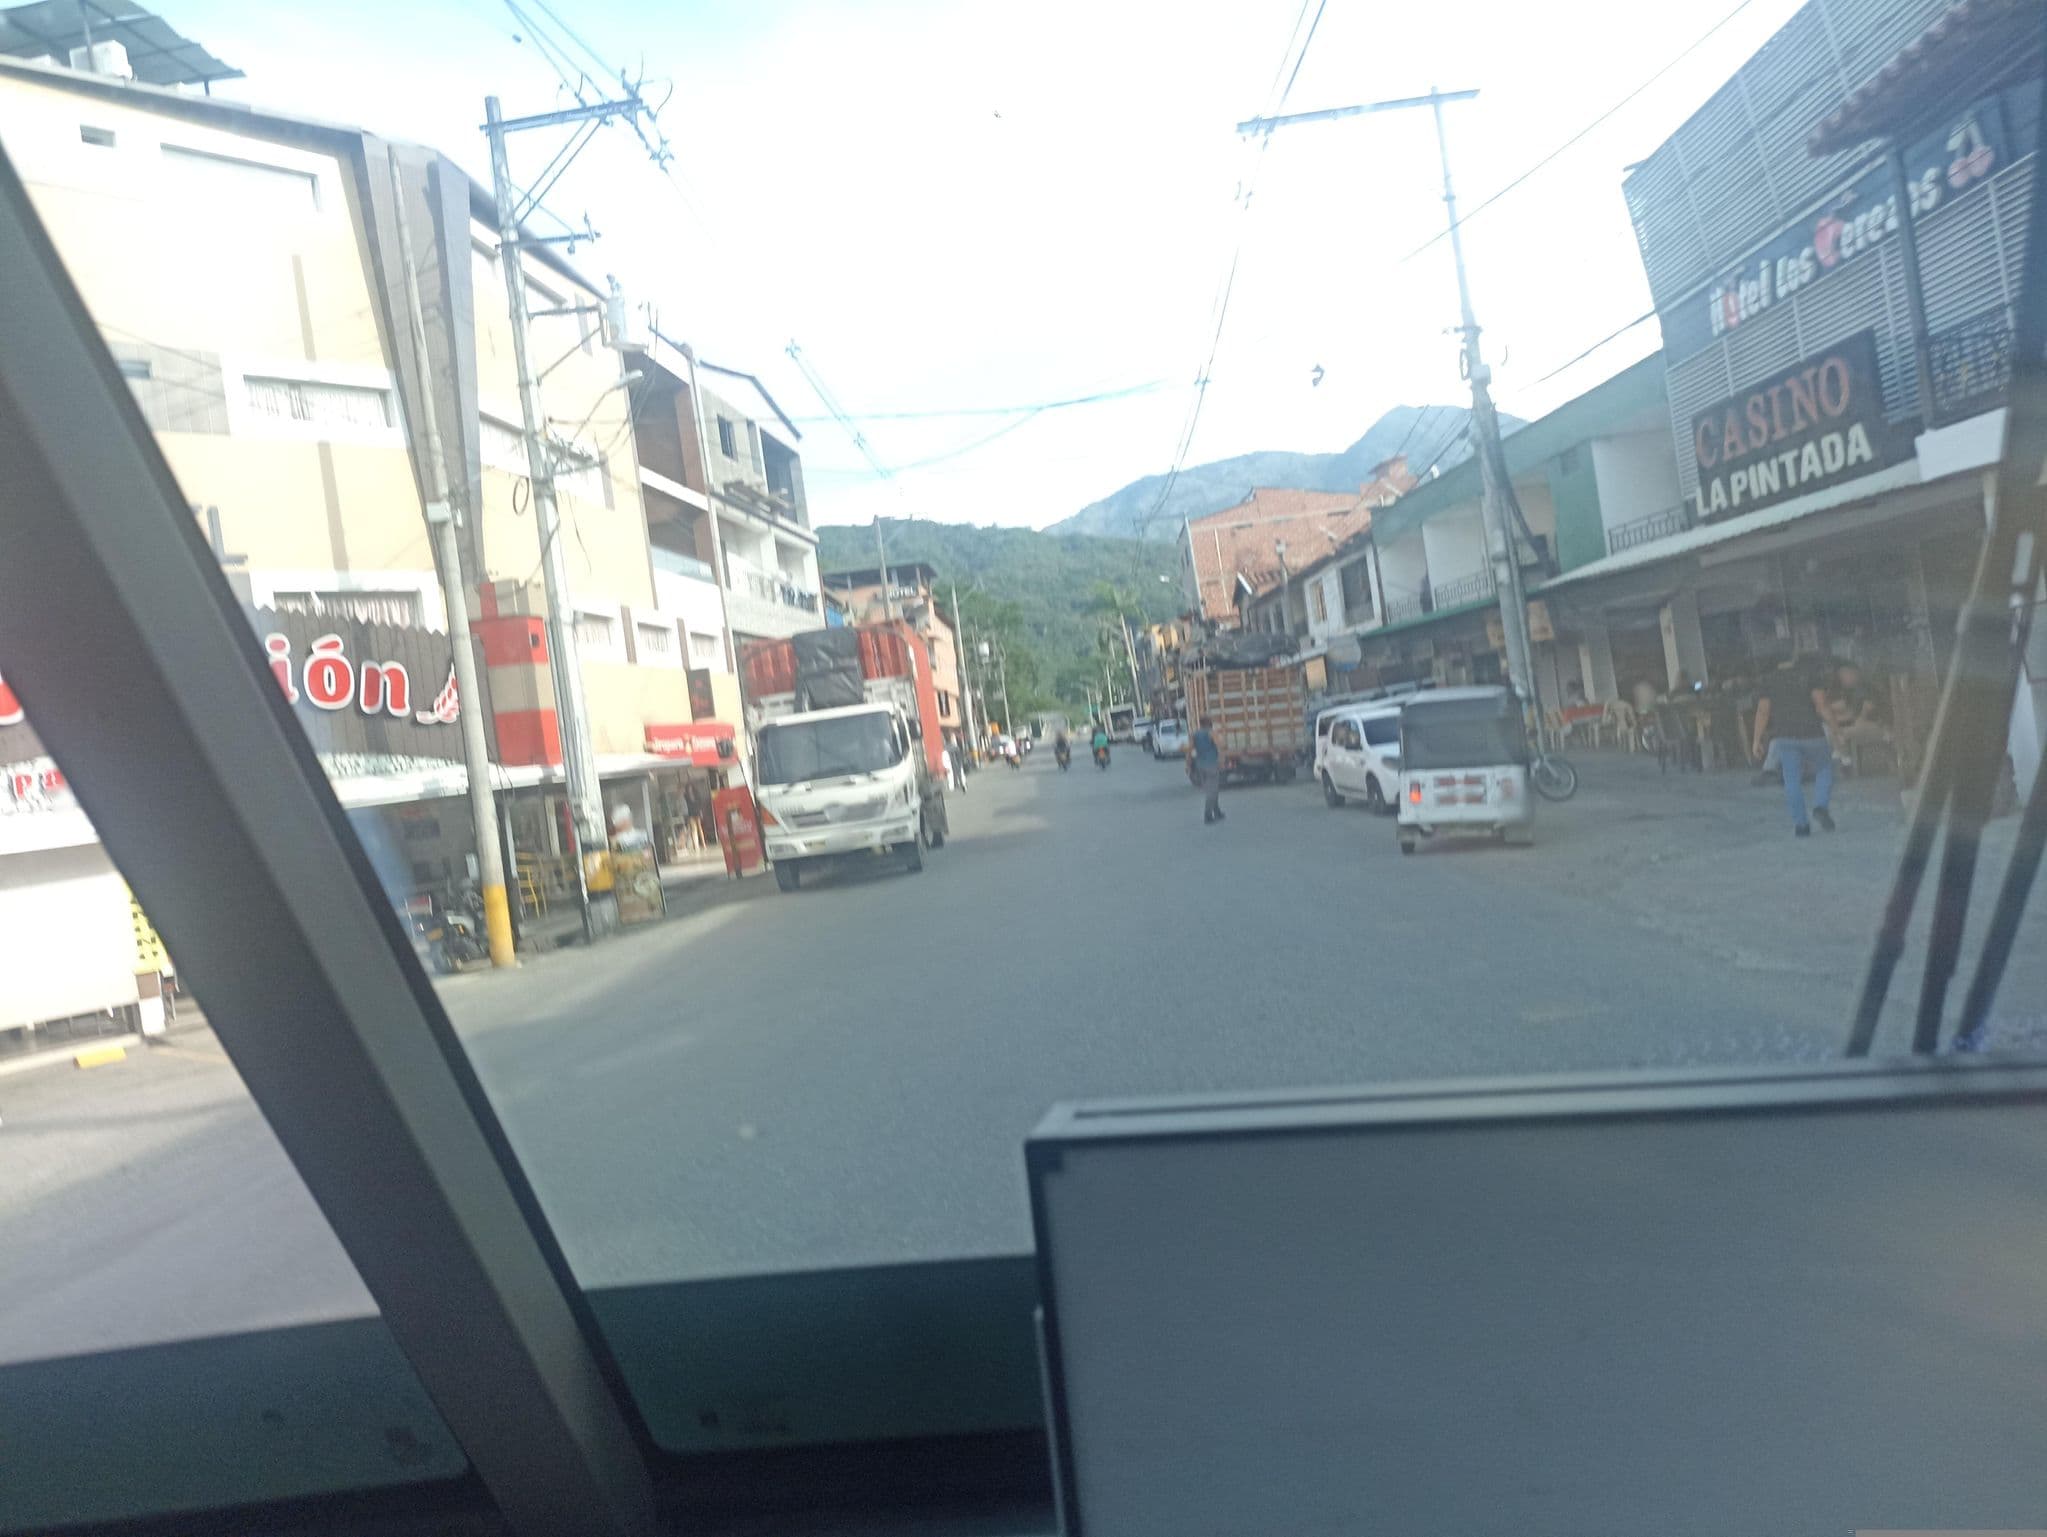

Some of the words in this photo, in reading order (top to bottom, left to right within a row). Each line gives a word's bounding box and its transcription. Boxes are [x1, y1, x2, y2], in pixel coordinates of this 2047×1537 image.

[1695, 357, 1850, 468] CASINO
[1695, 476, 1728, 517] LA
[1730, 422, 1873, 507] PINTADA
